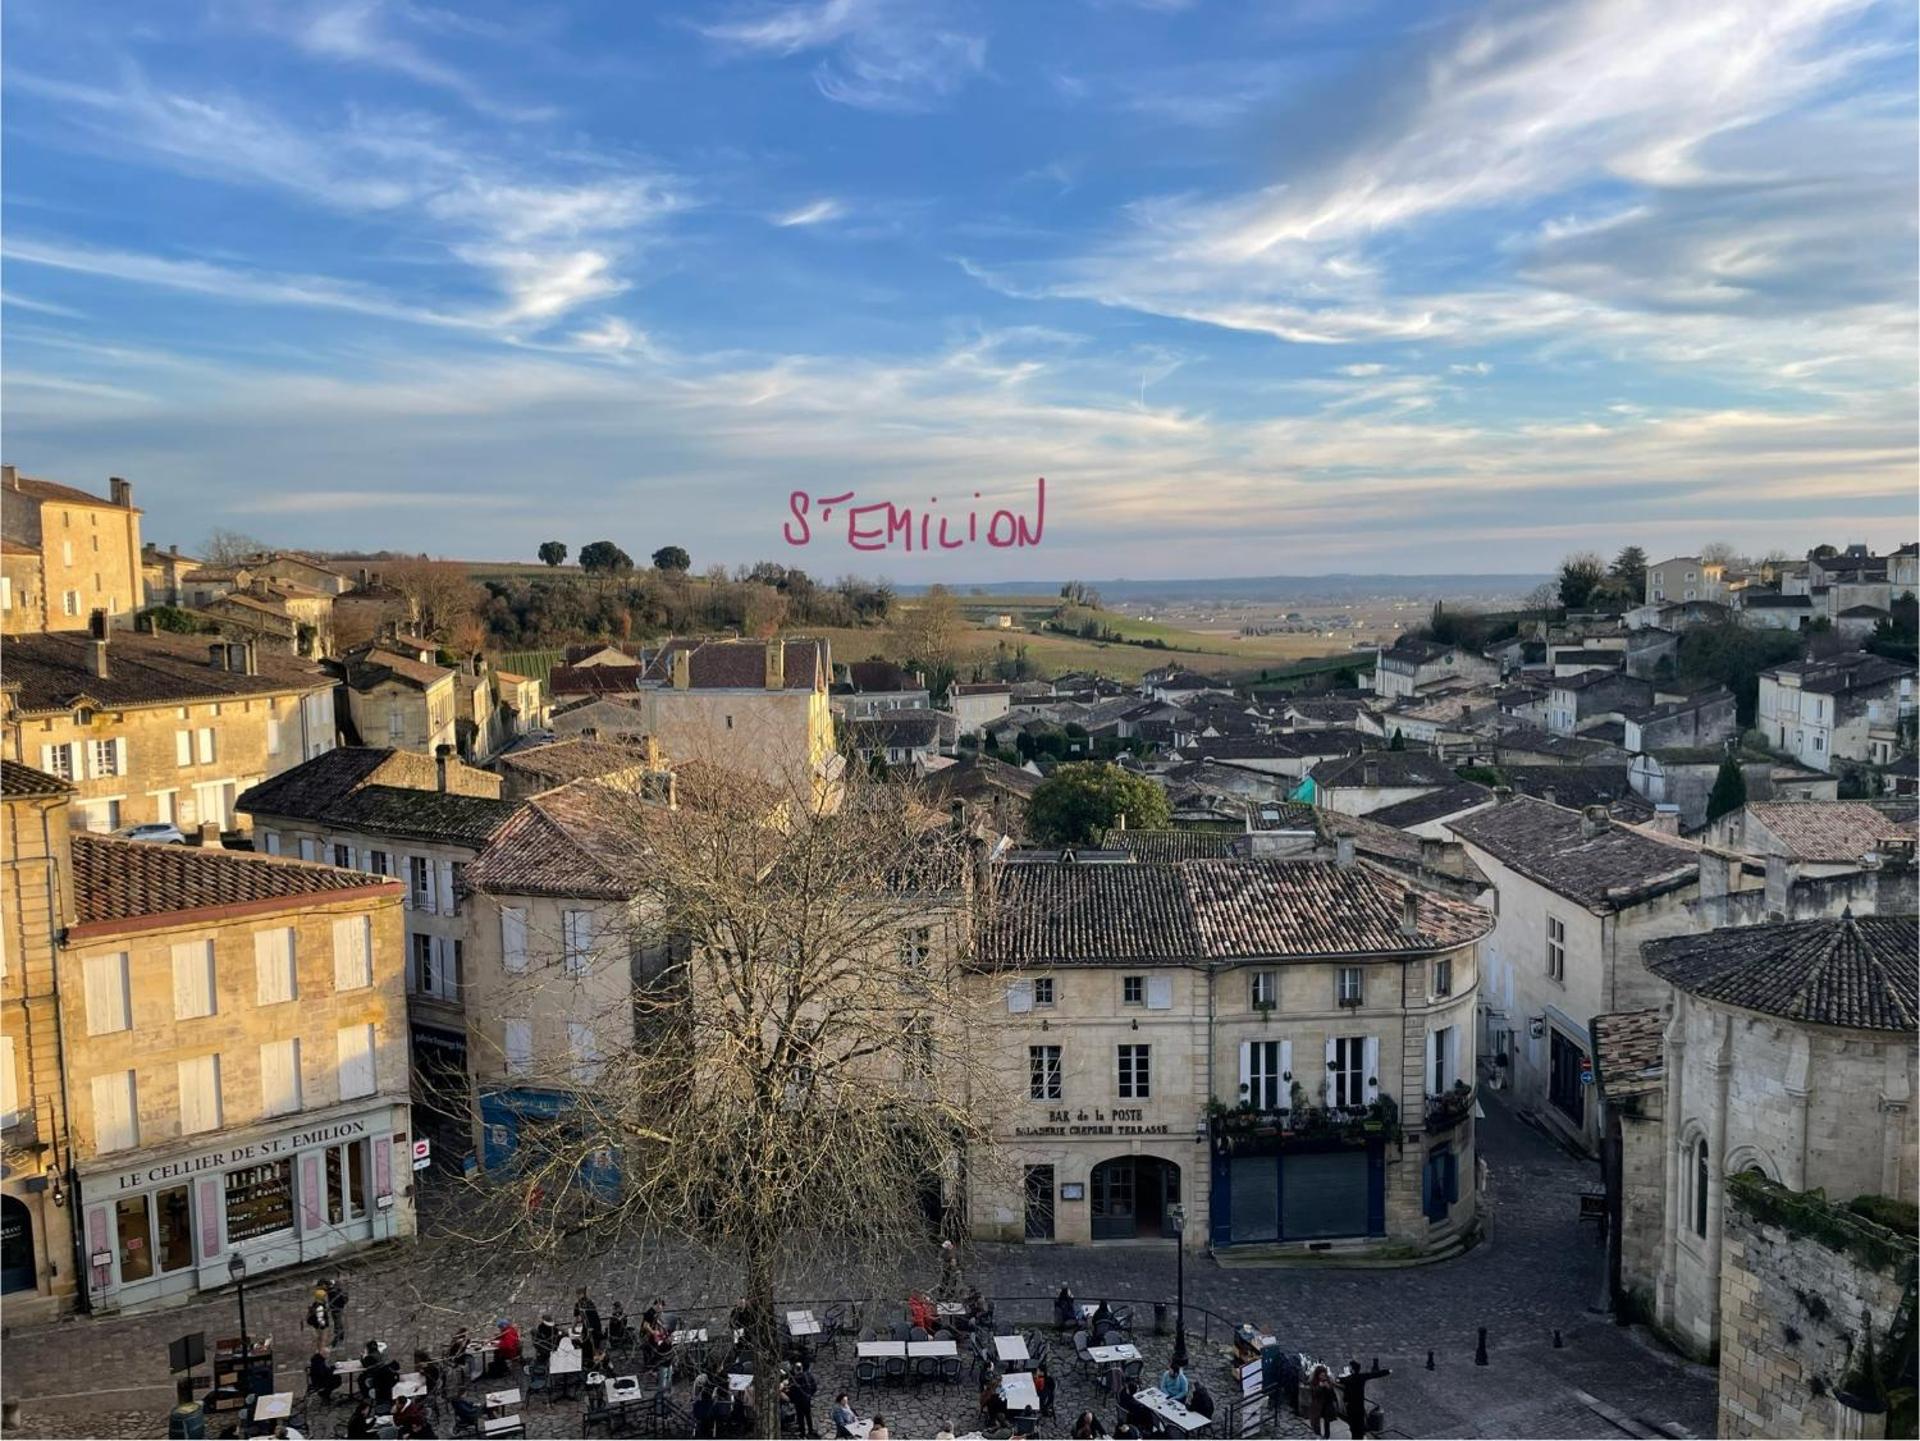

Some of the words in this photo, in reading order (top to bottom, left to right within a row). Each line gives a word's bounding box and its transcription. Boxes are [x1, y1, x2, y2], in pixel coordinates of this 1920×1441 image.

[1048, 1110, 1070, 1122] BAR
[1077, 1110, 1089, 1121] de
[1096, 1109, 1104, 1121] la
[1112, 1109, 1143, 1121] POSTE
[1118, 1125, 1168, 1135] TERRASSE
[120, 1173, 142, 1189] LE
[148, 1154, 225, 1181] CELLIER
[231, 1146, 255, 1162] DE
[261, 1140, 286, 1154] ST.
[292, 1120, 364, 1148] EMILION
